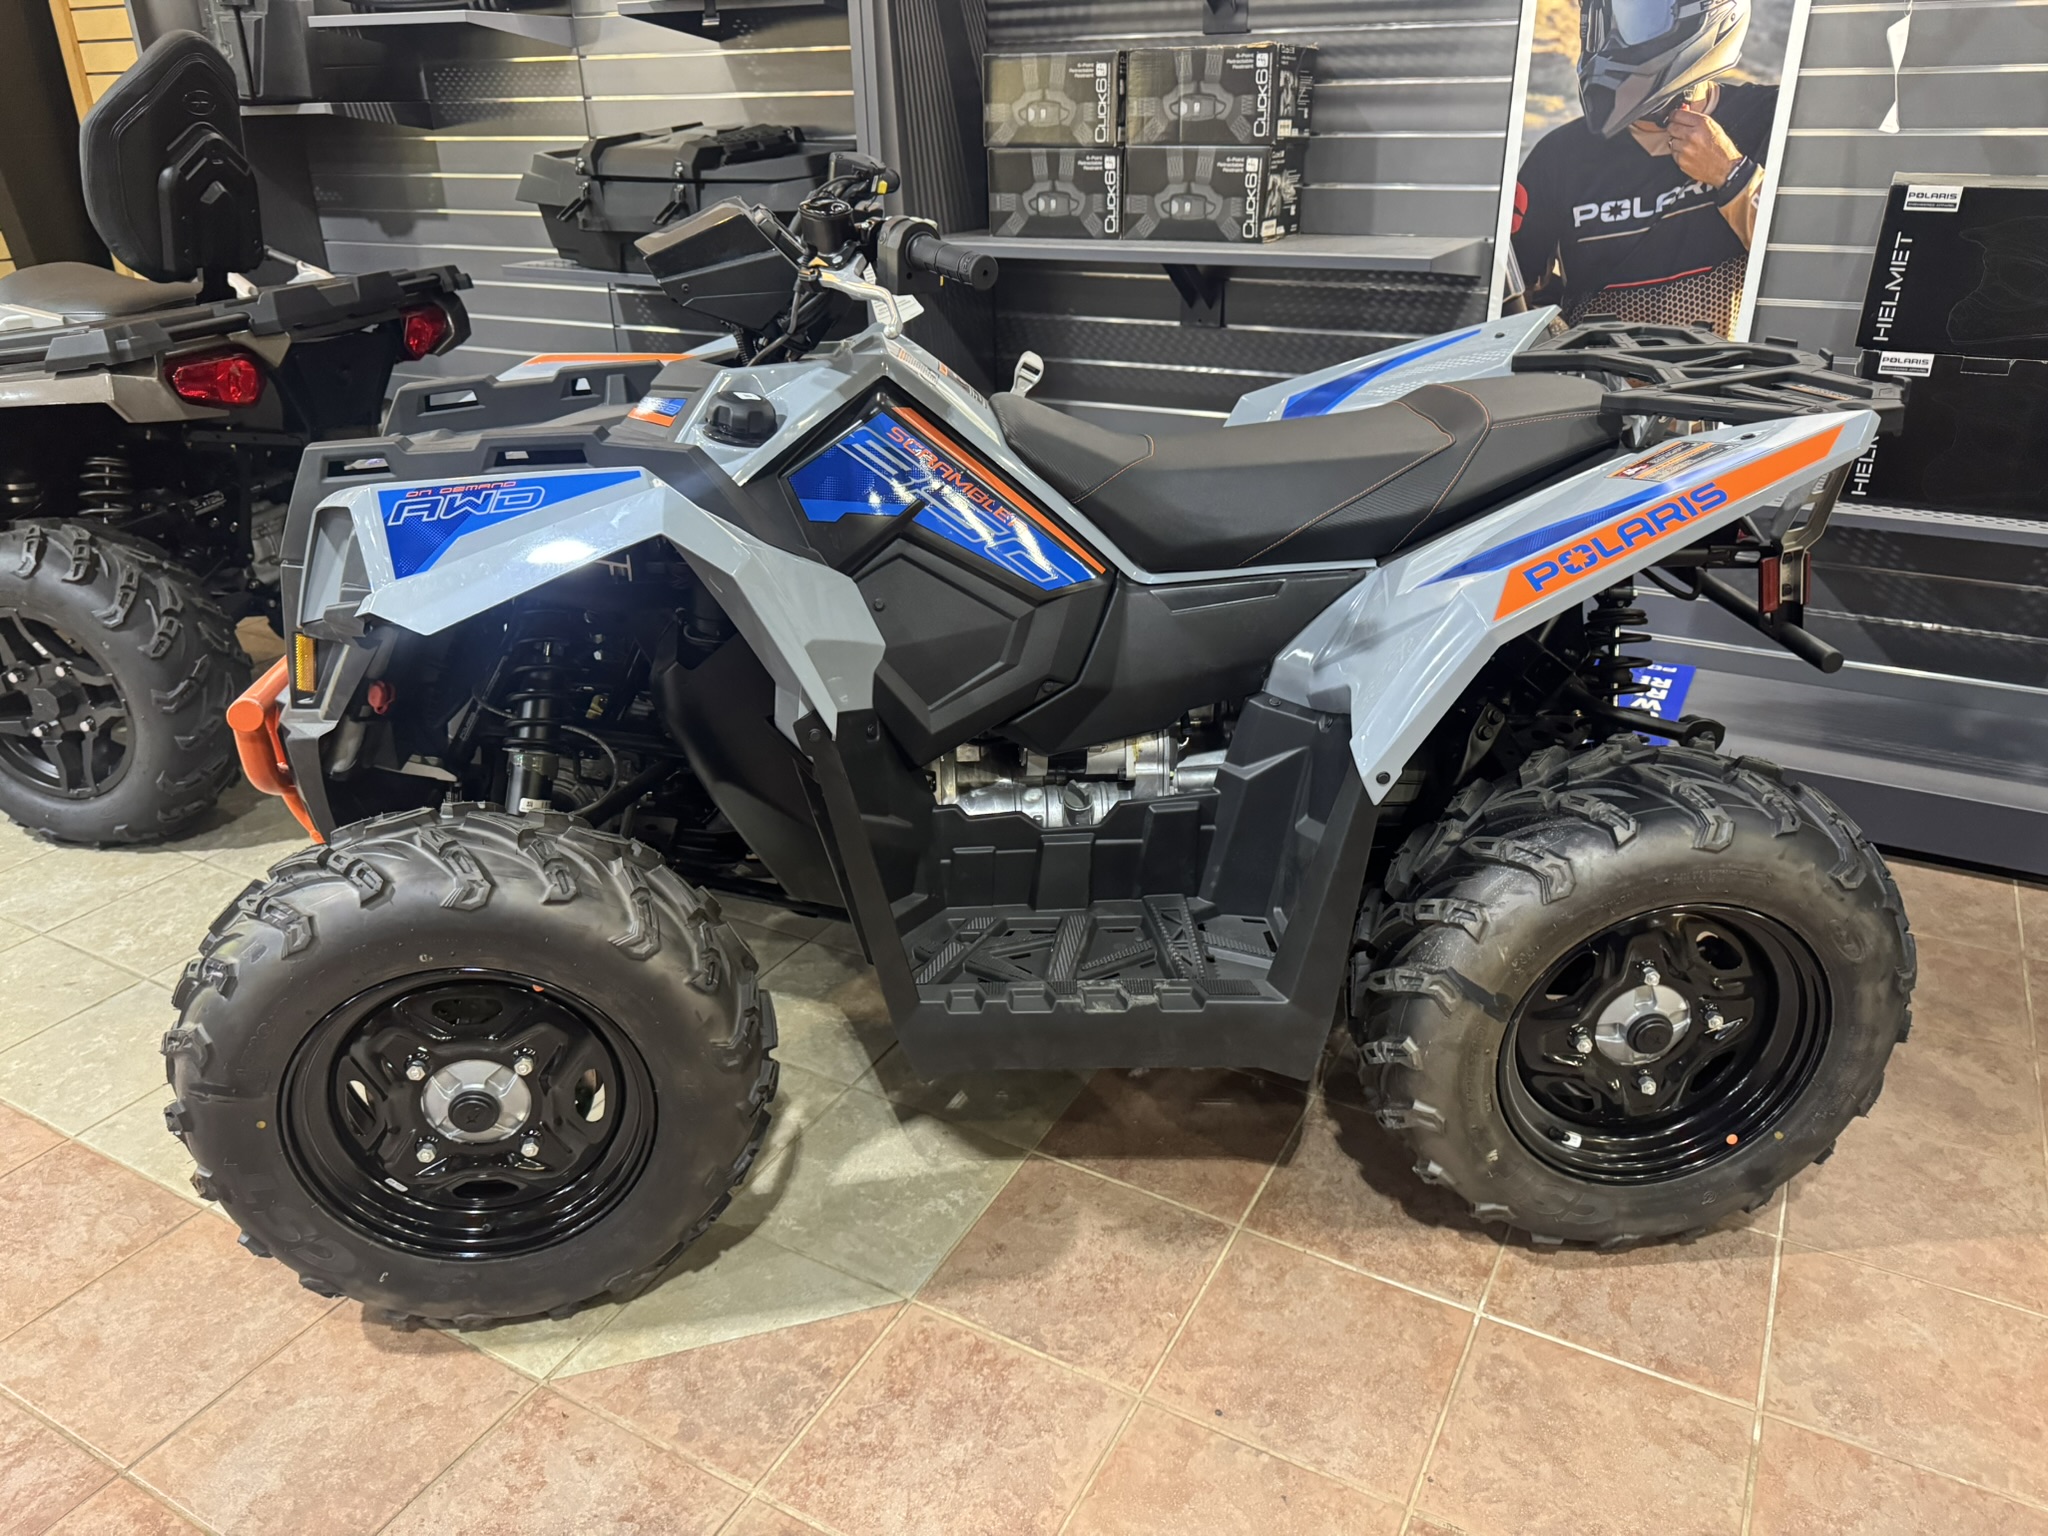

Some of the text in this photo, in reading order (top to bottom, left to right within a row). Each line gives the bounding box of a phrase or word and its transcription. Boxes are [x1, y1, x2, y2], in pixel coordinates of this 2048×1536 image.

[1908, 191, 1958, 200] POLARIS
[1872, 231, 1914, 342] HELMET
[1882, 356, 1929, 365] POLARIS
[406, 481, 517, 499] ON DEMAND
[887, 426, 1029, 534] SCRAMBLER
[388, 486, 546, 527] AWD
[1522, 482, 1729, 593] POLARIS
